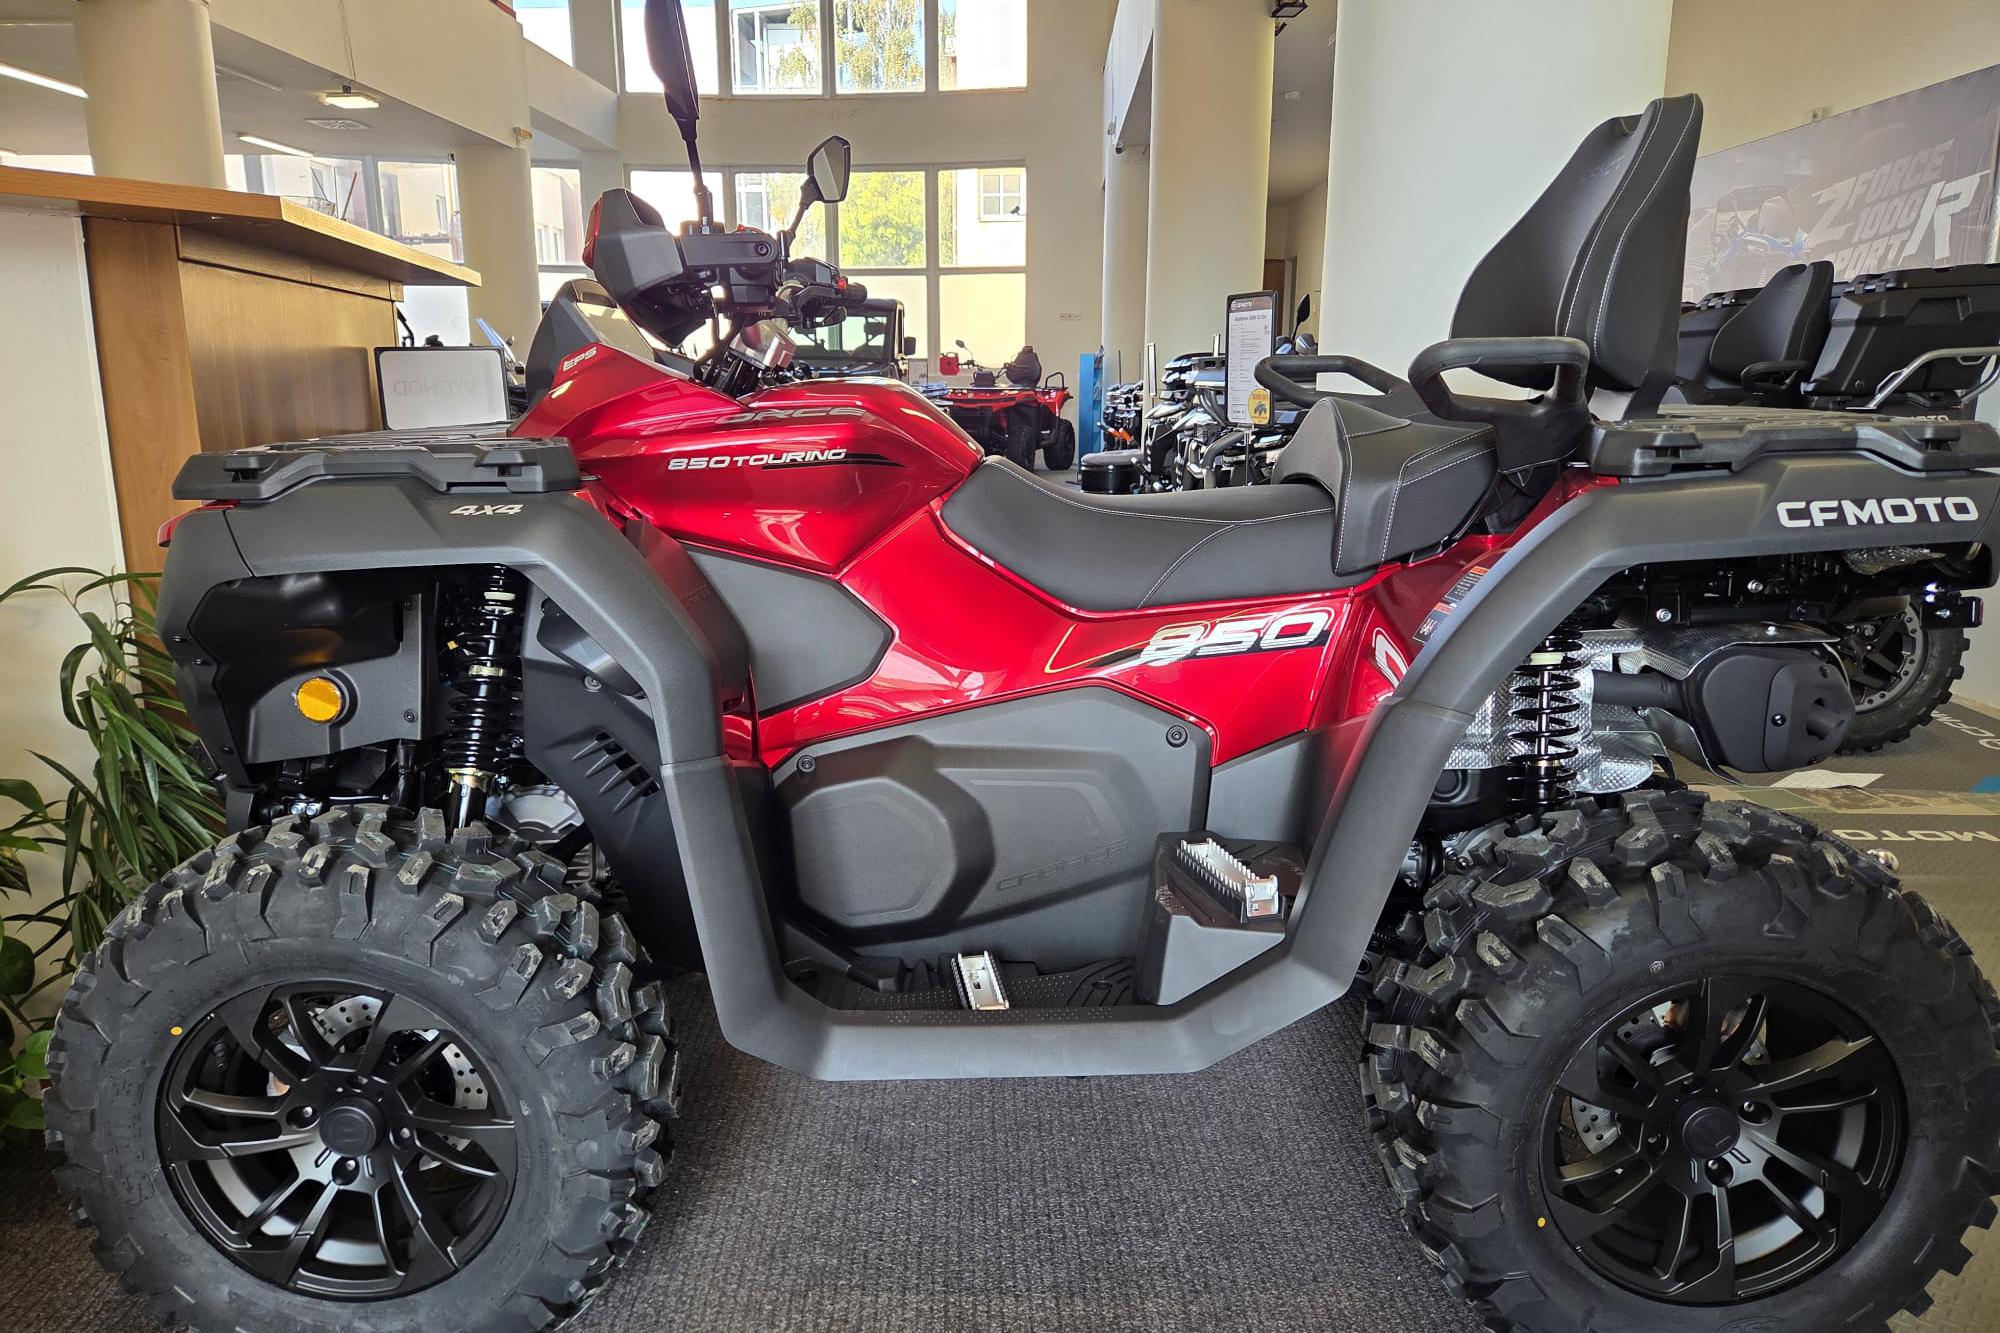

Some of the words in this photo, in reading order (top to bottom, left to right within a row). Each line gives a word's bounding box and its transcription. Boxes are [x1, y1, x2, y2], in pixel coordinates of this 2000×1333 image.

[562, 346, 597, 372] EPS
[667, 455, 730, 471] 850
[731, 449, 848, 468] TOURING
[1776, 496, 1980, 528] CFMOTO
[1139, 608, 1334, 666] 850
